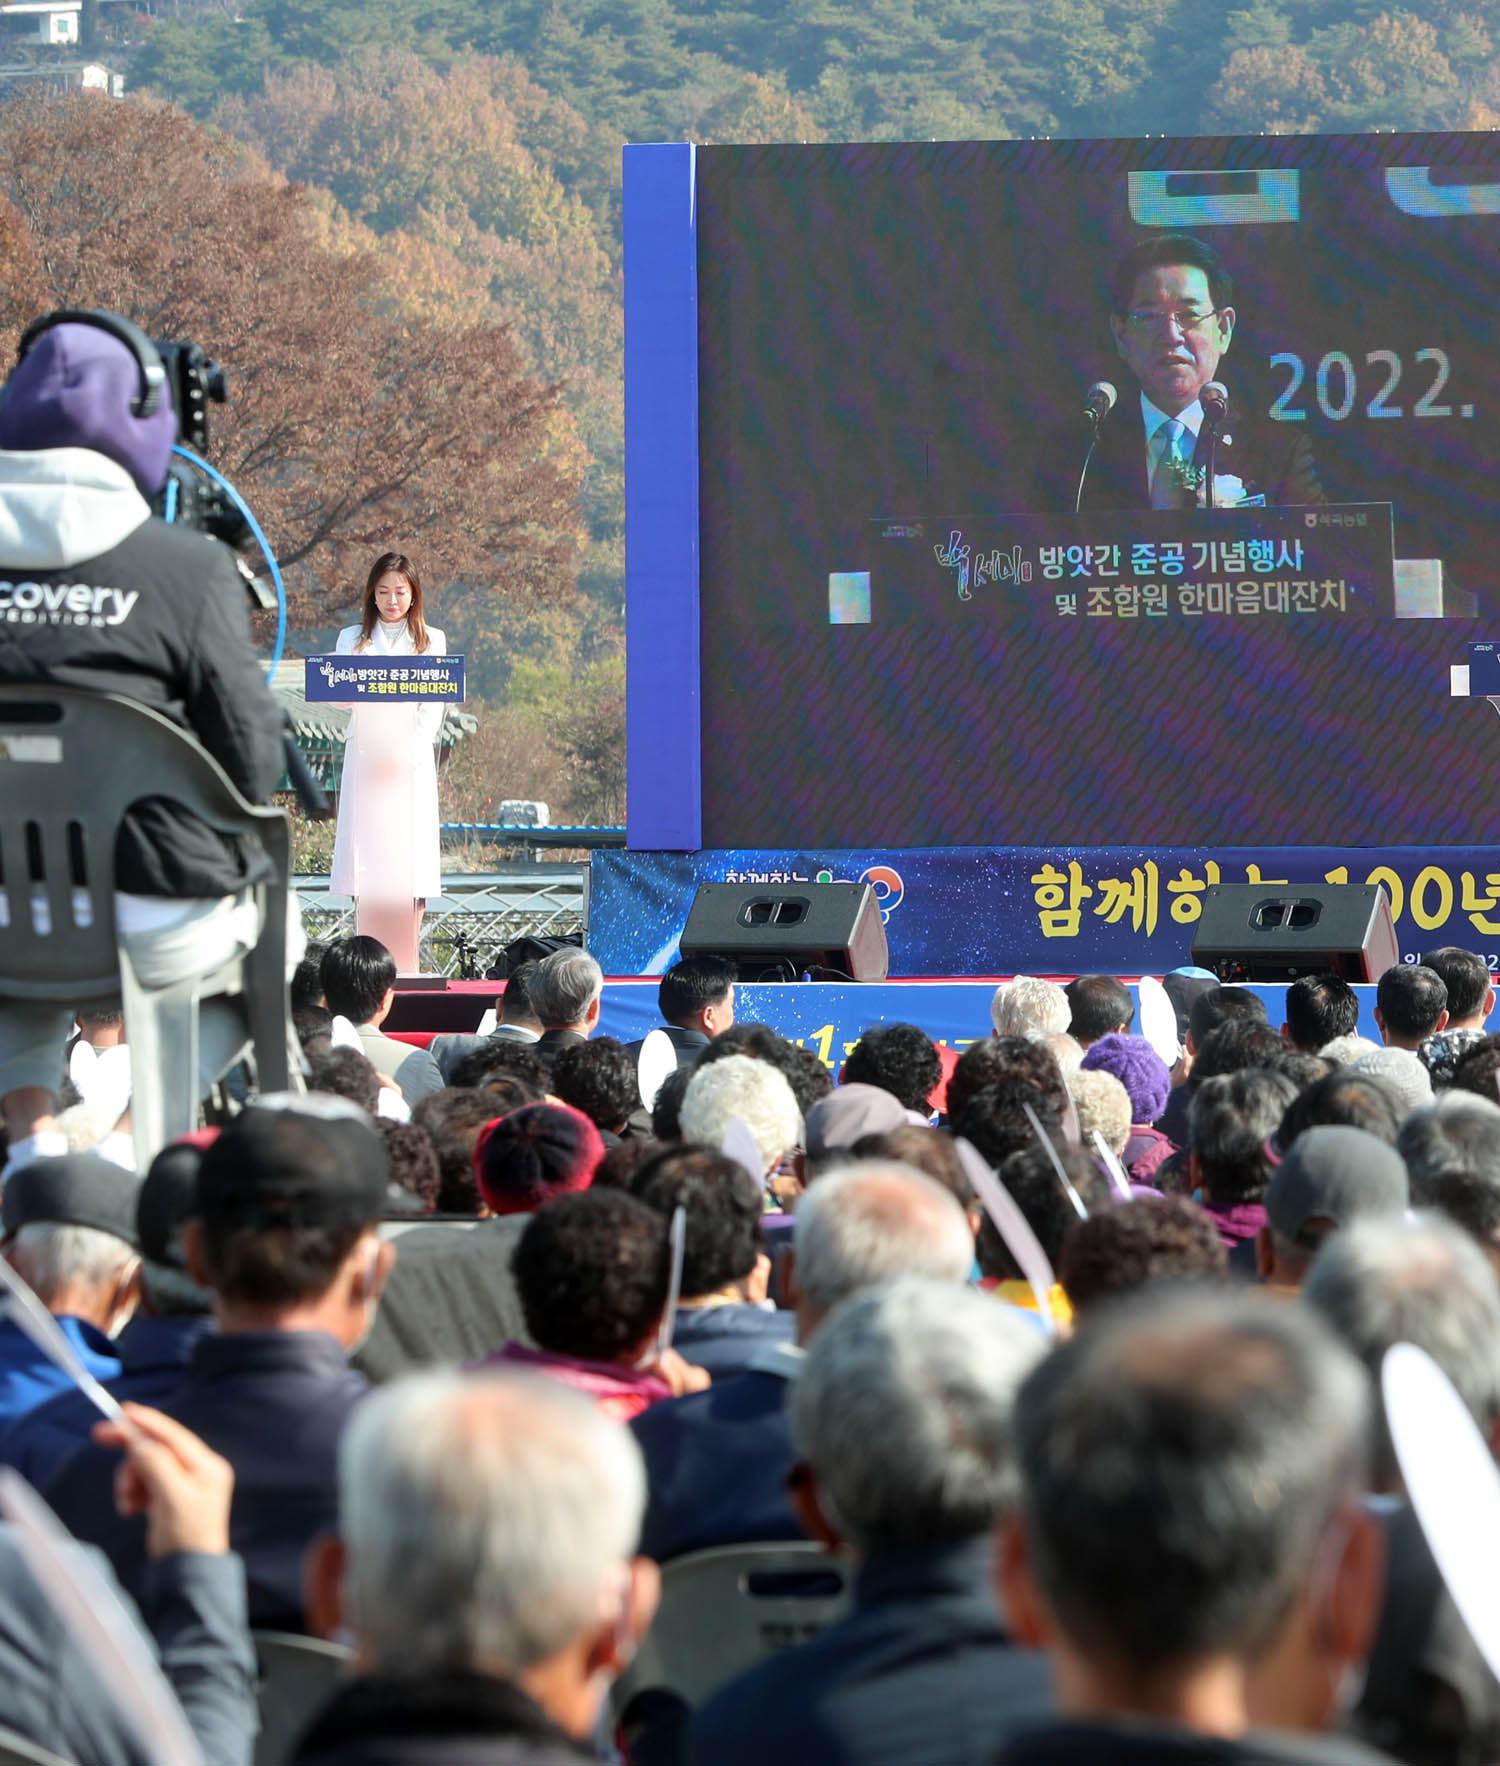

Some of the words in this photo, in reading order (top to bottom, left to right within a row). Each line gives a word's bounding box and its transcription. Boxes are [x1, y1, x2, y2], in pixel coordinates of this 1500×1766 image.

[1267, 347, 1475, 421] 2022.
[1039, 544, 1121, 580] 방앗간
[1130, 542, 1185, 576] 준공
[1191, 538, 1304, 573] 기념행사
[1055, 593, 1077, 616] 및
[1086, 582, 1171, 617] 조합원
[1177, 578, 1348, 615] 한마음대잔치
[0, 608, 105, 627] EDITION
[357, 669, 387, 681] 방앗간
[390, 669, 410, 681] 준공
[411, 668, 449, 681] 기념행사
[368, 682, 397, 694] 조합원
[399, 682, 458, 694] 한마음대잔치
